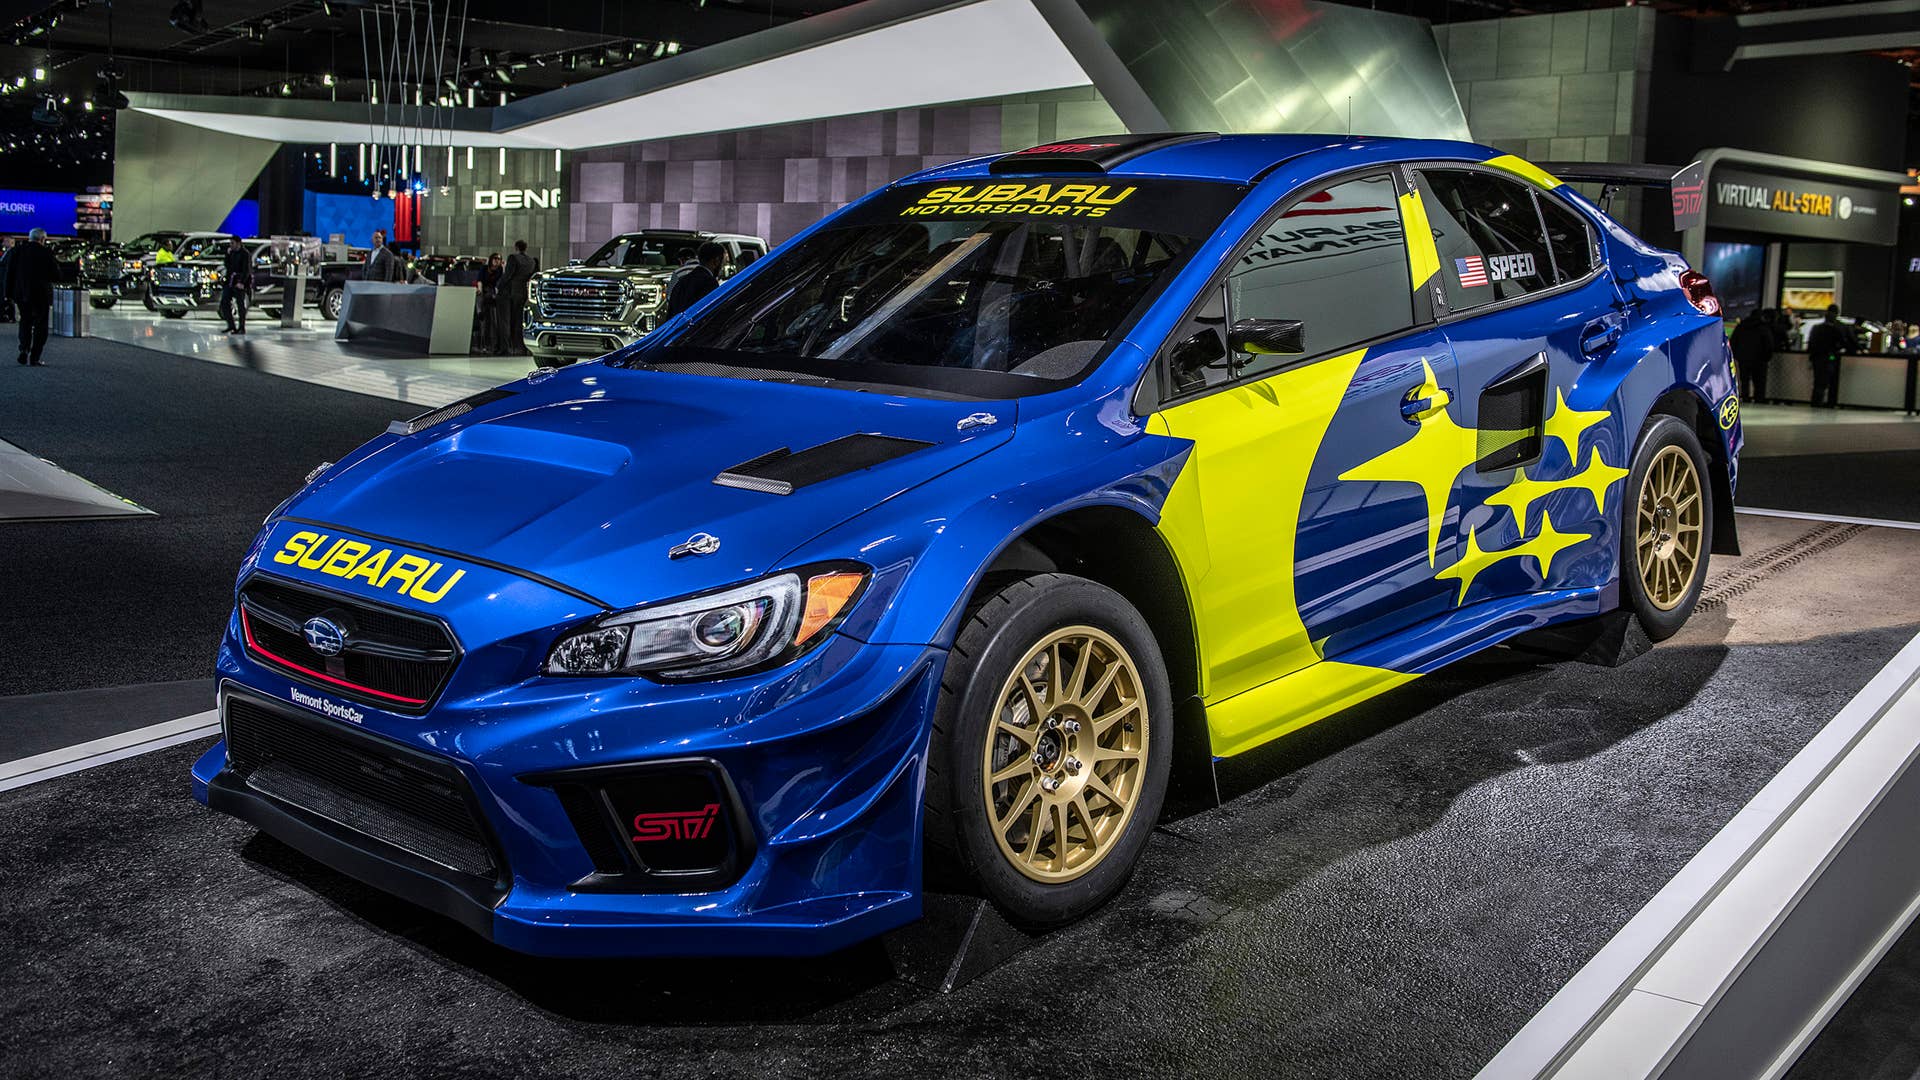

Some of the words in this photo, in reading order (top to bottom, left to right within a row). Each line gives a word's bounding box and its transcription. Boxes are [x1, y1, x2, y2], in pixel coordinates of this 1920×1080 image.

[917, 183, 1137, 205] SUBARU
[1716, 182, 1771, 209] VIRTUAL
[1773, 189, 1832, 216] ALL-STAR
[900, 204, 1112, 218] MOTORSPORTS
[1489, 253, 1536, 281] SPEED
[273, 531, 466, 603] SUBARU
[290, 687, 322, 710] Vermont
[322, 699, 364, 724] SportsCar
